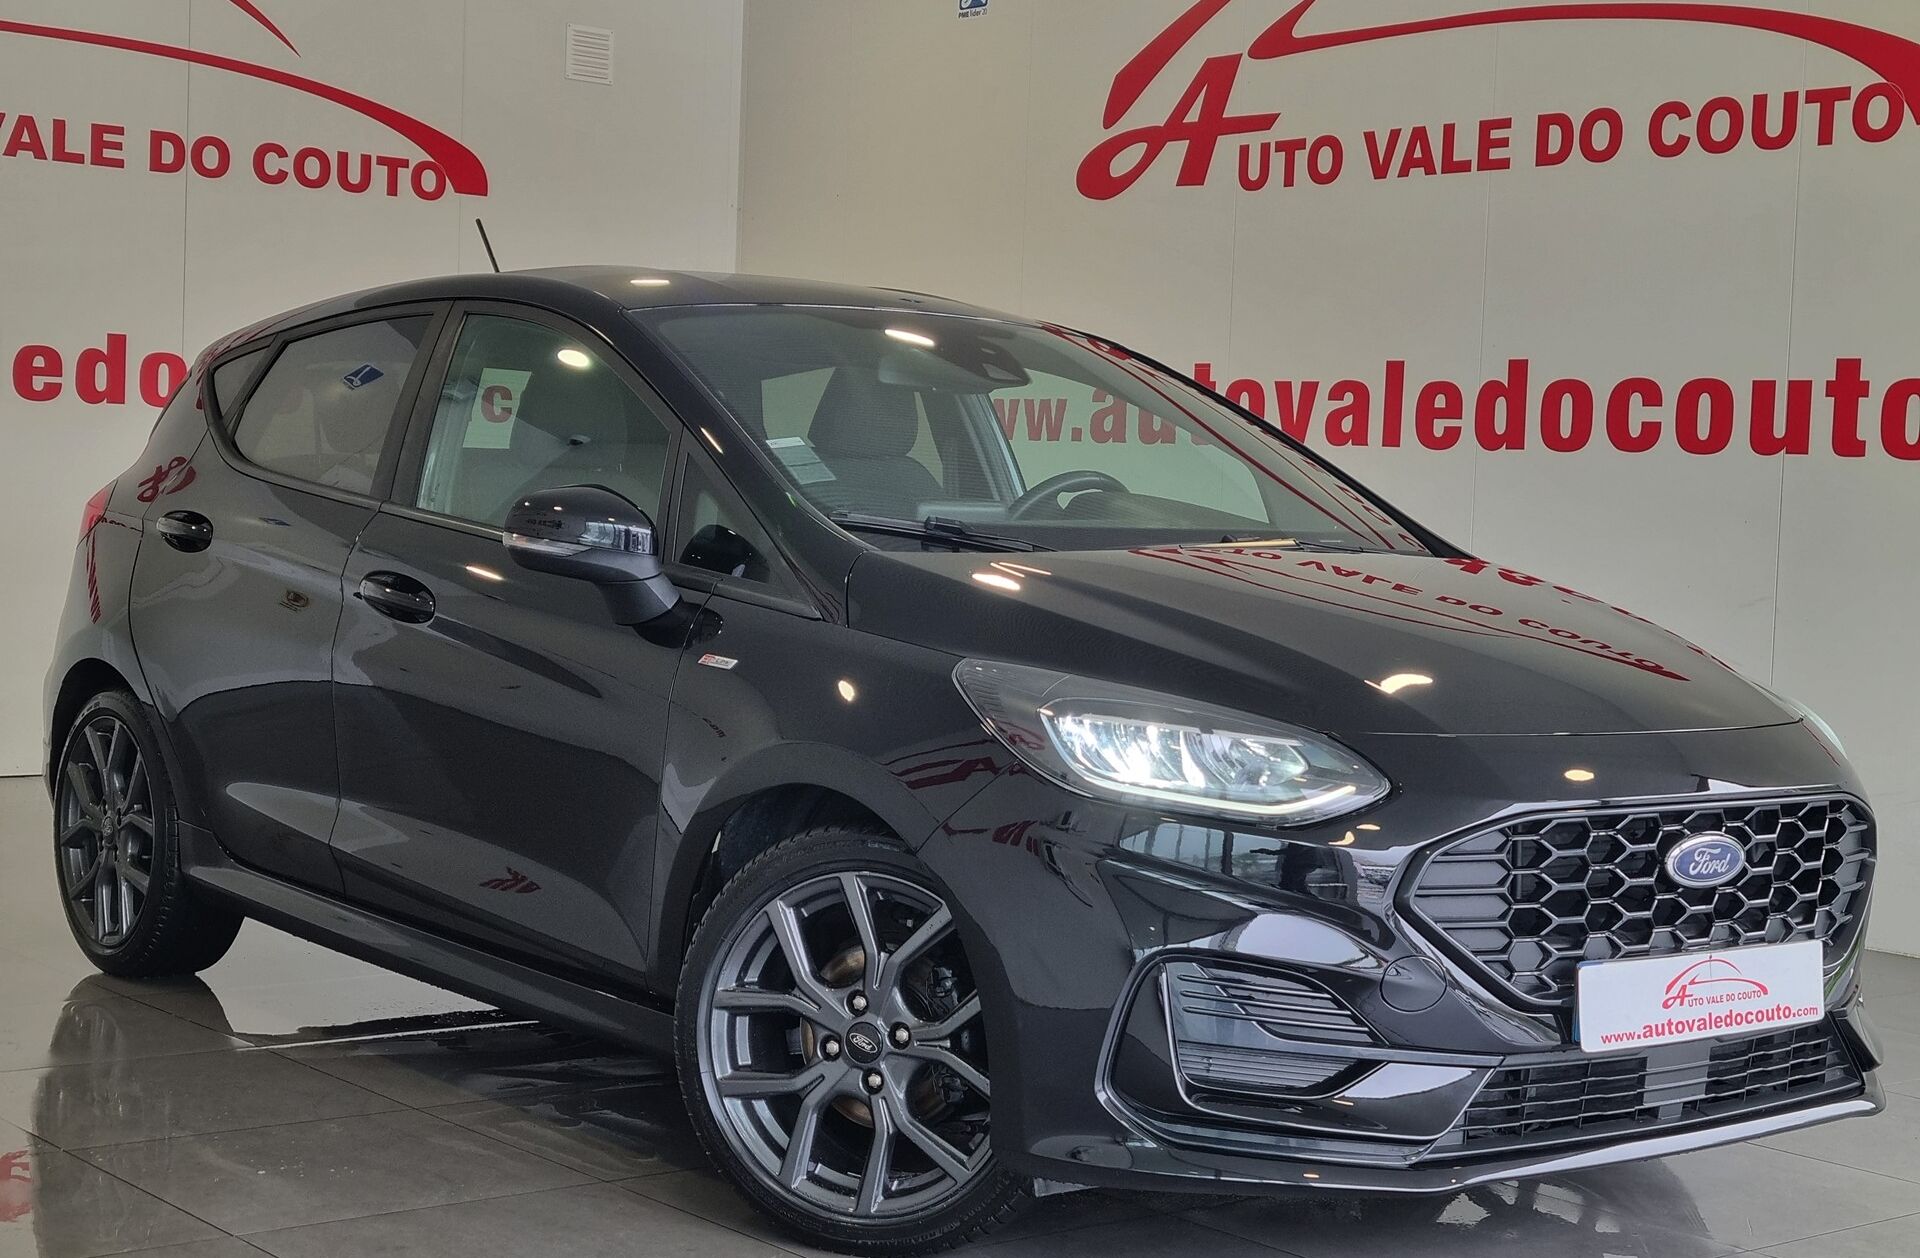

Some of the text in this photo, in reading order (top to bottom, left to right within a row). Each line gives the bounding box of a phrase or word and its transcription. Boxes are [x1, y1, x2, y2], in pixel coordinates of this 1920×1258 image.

[1075, 52, 1905, 201] AUTO VALE DO COUTO
[0, 112, 446, 201] ALE DO COUTO
[1689, 847, 1731, 876] Ford
[1706, 994, 1724, 1005] VALE
[1725, 993, 1736, 1002] DO
[1737, 990, 1762, 1000] COUTO
[1600, 1003, 1819, 1045] www.autovaledocouto.com
